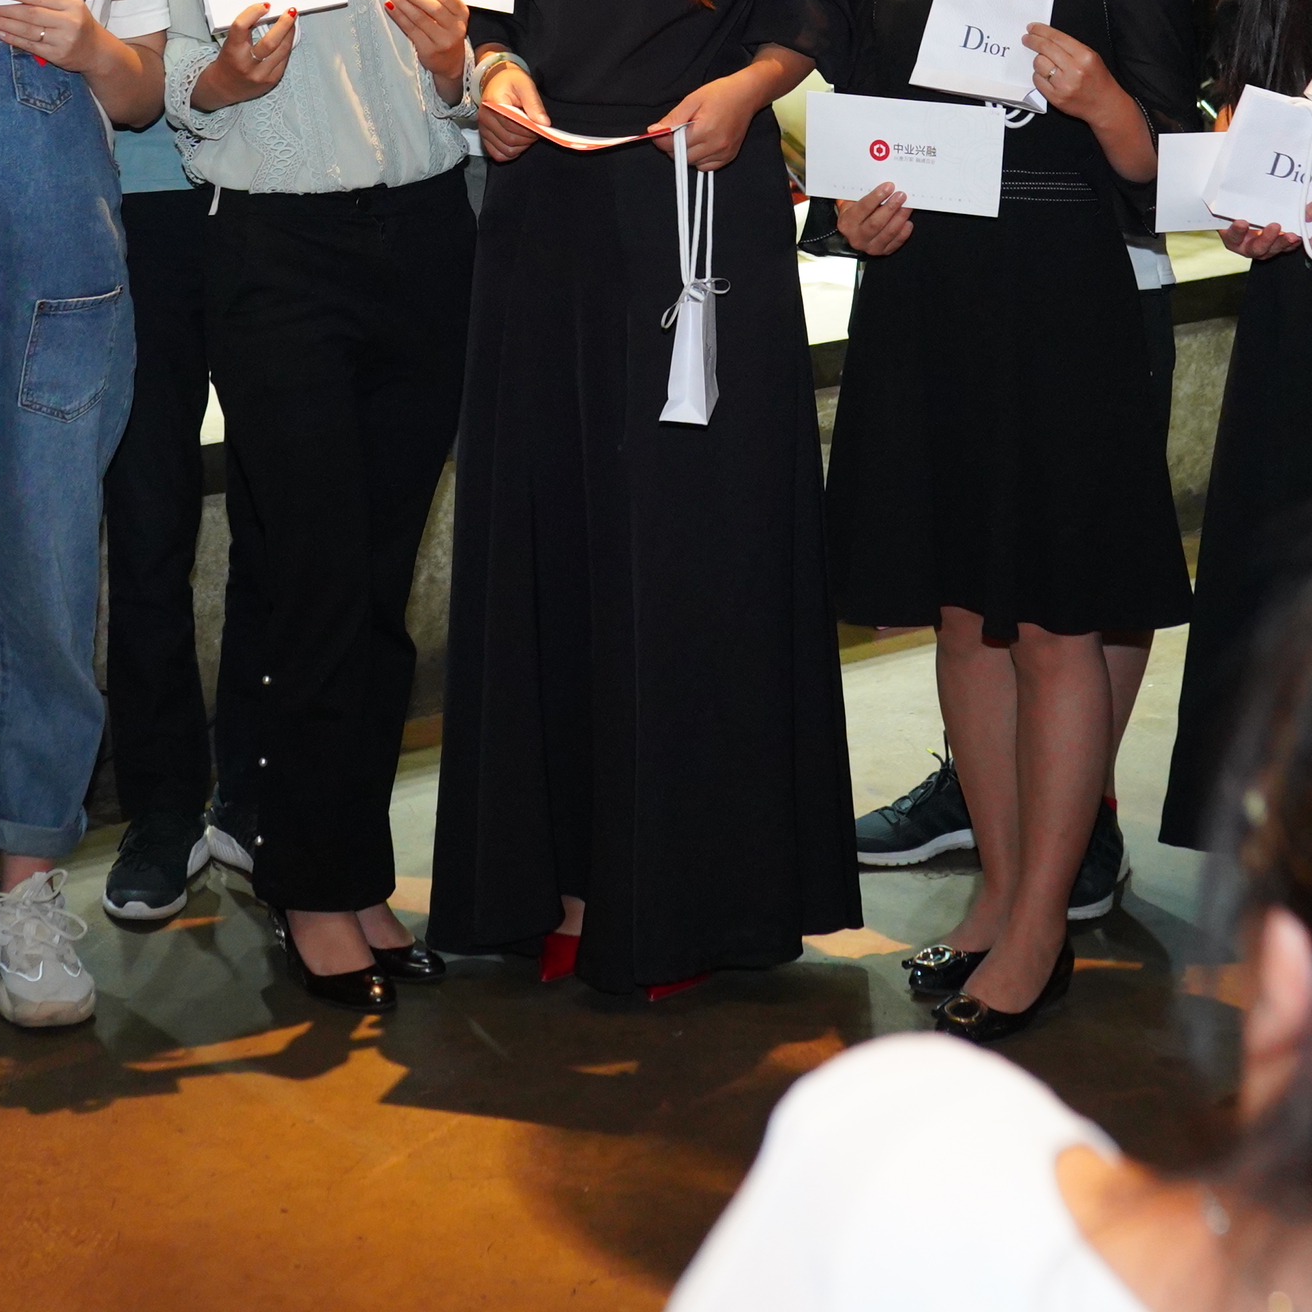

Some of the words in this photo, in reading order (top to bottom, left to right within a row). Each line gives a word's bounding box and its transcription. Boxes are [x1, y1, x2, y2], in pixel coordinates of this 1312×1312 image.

[959, 24, 1010, 58] Dior
[893, 142, 937, 157] 中业兴融
